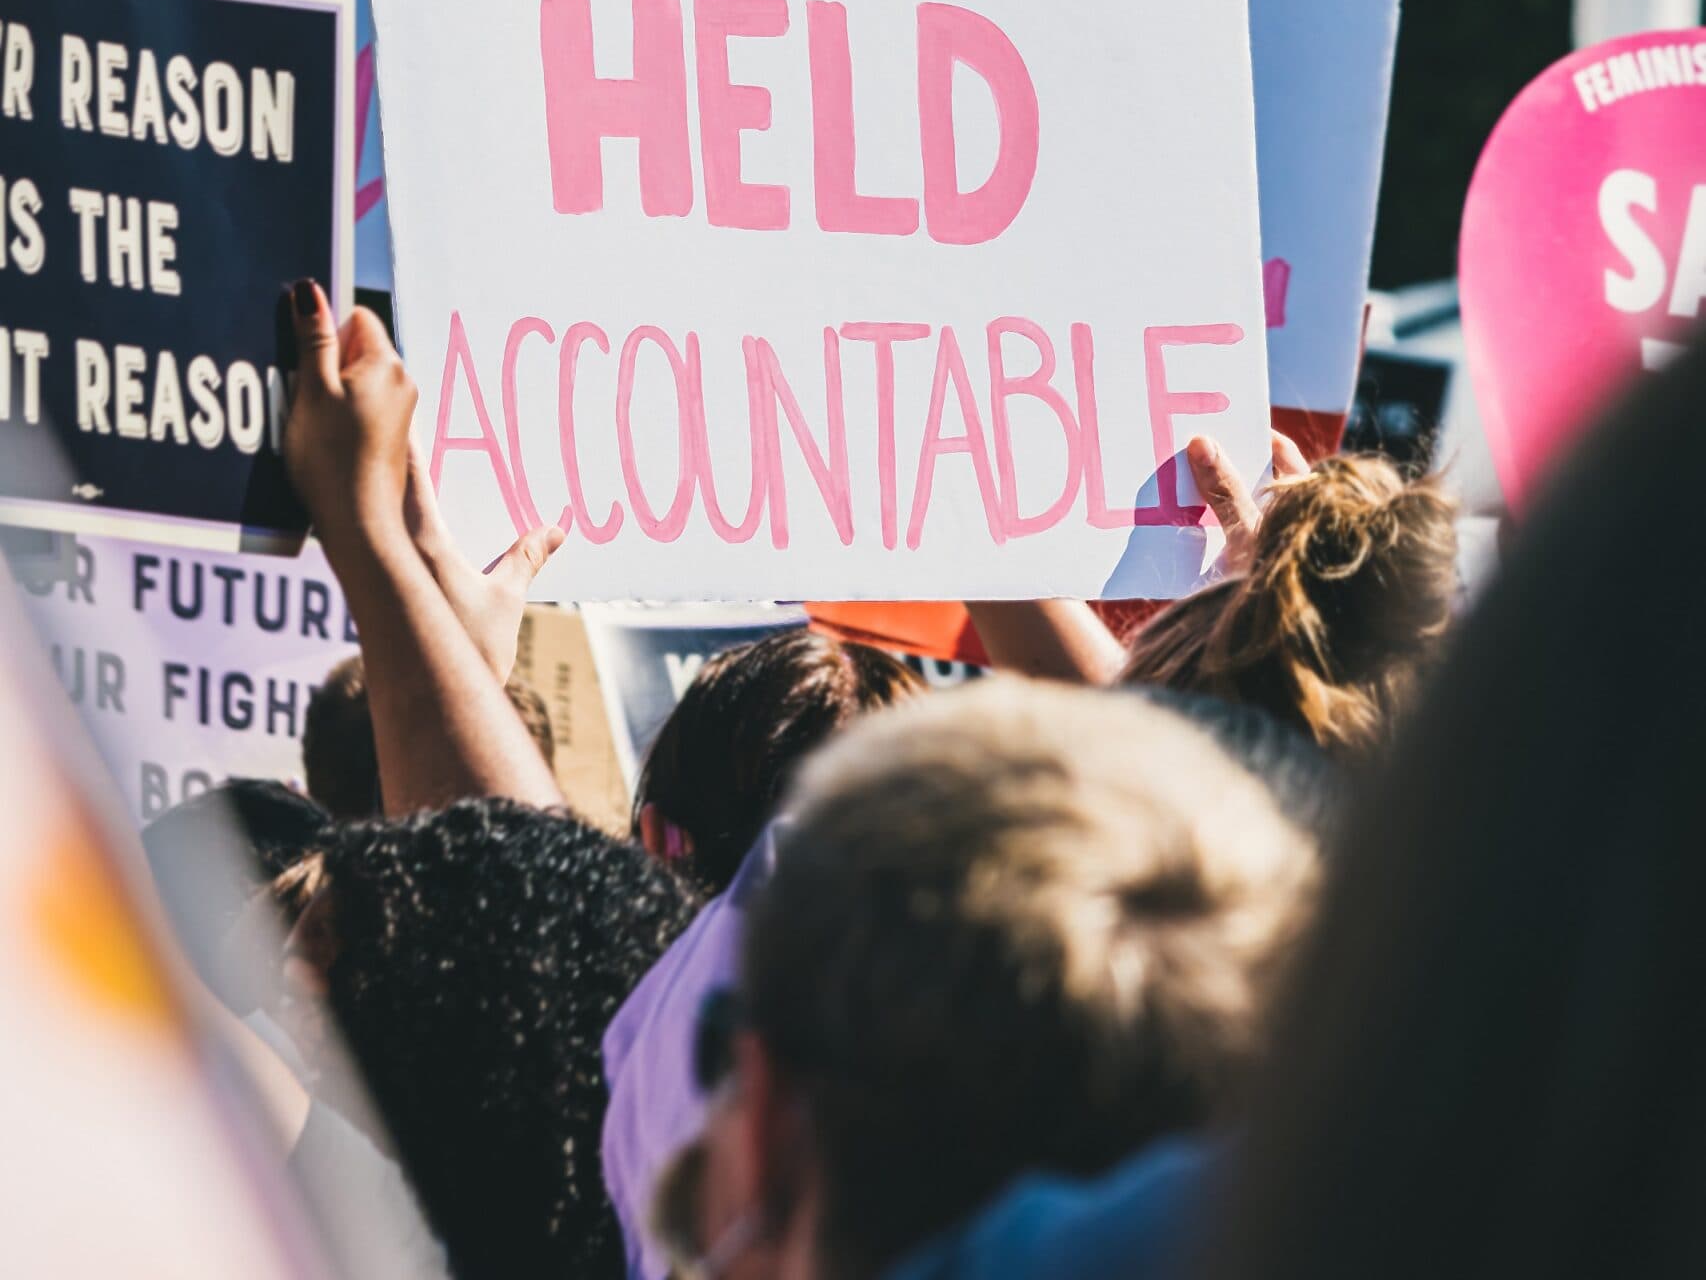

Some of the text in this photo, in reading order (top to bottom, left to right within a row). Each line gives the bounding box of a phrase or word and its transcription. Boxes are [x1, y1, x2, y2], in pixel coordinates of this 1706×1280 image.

[60, 32, 295, 163] REASON
[68, 187, 182, 297] THE
[430, 309, 1245, 551] ACCOUNTABLE
[162, 660, 322, 738] FIGH
